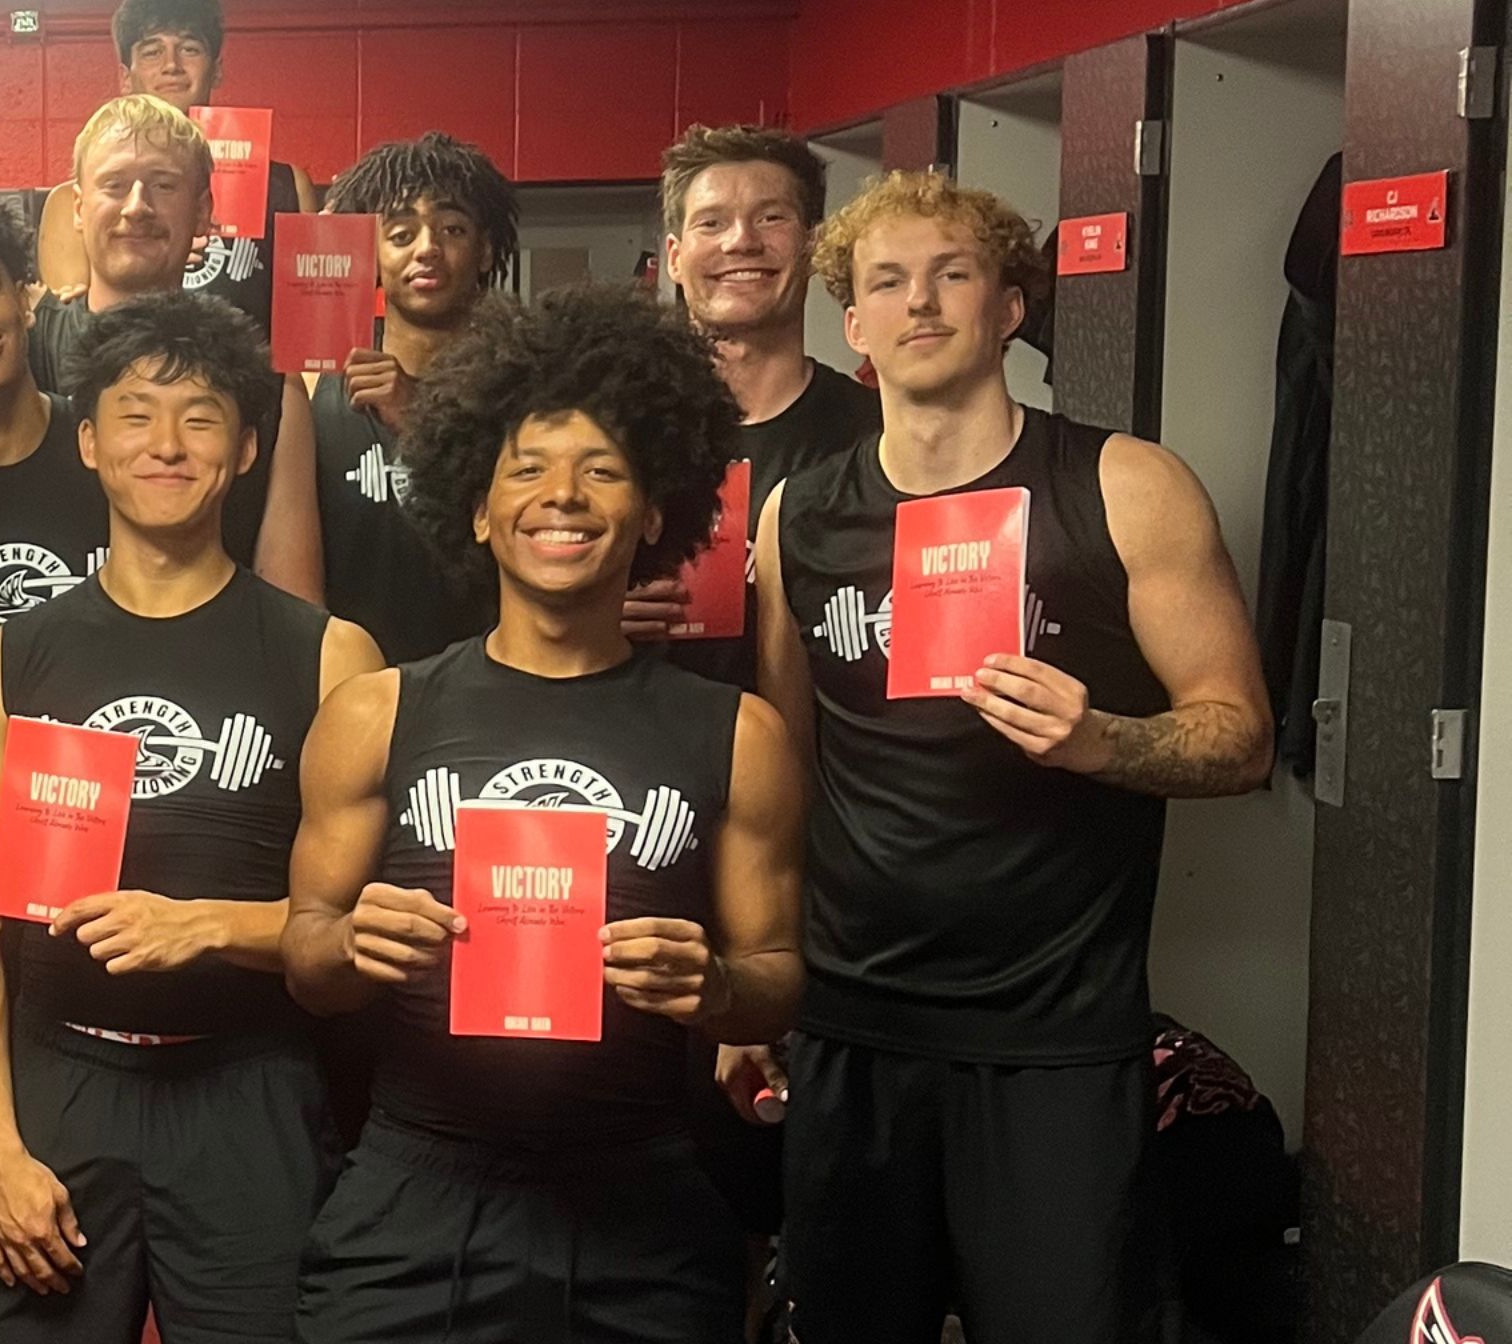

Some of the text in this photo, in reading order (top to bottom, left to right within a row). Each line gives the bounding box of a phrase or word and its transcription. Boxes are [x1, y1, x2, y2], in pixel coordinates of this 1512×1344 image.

[296, 253, 352, 278] VICTORY
[921, 540, 992, 576] VICTORY
[30, 770, 102, 812] VICTORY
[133, 755, 197, 795] TIONING
[492, 763, 612, 802] STRENGTH
[491, 865, 574, 900] VICTORY
